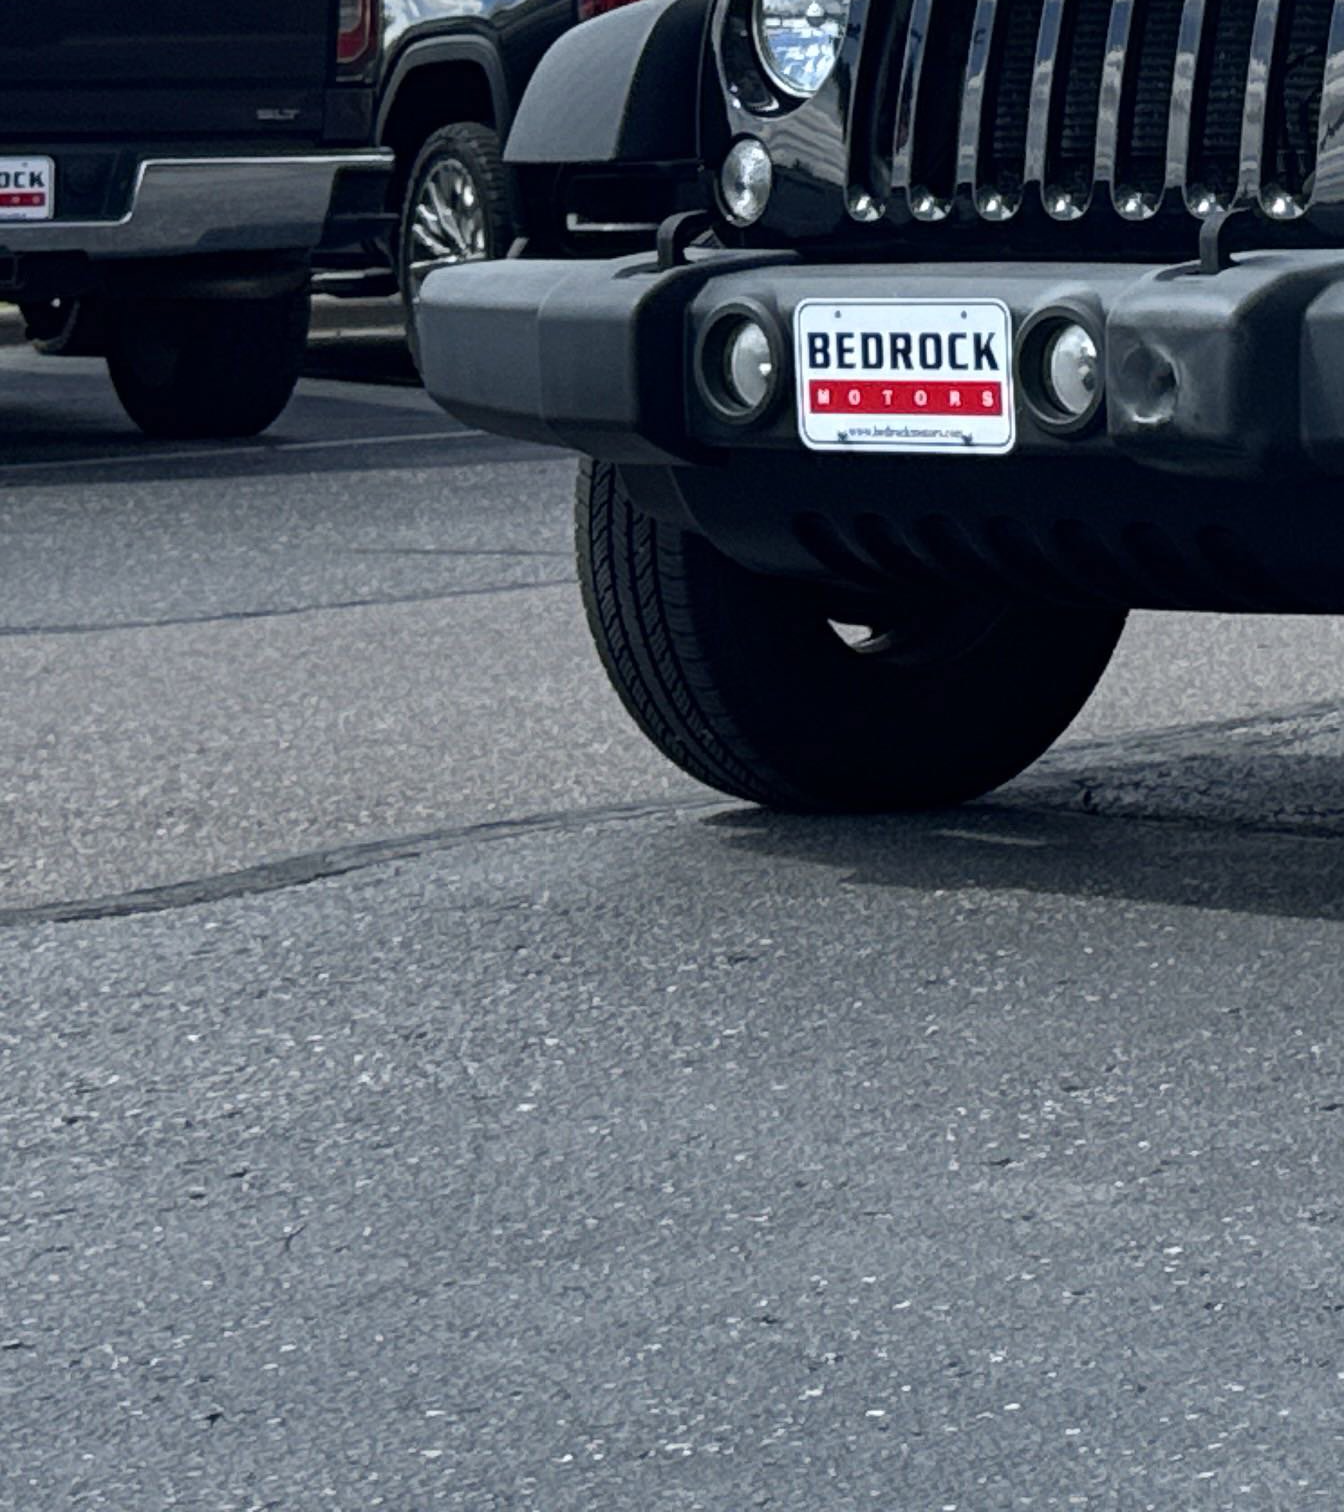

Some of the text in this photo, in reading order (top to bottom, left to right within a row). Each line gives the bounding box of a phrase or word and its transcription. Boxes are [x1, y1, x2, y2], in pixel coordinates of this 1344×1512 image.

[0, 171, 45, 189] OCK
[807, 331, 1000, 371] BEDROCK
[816, 388, 994, 408] MOTORS
